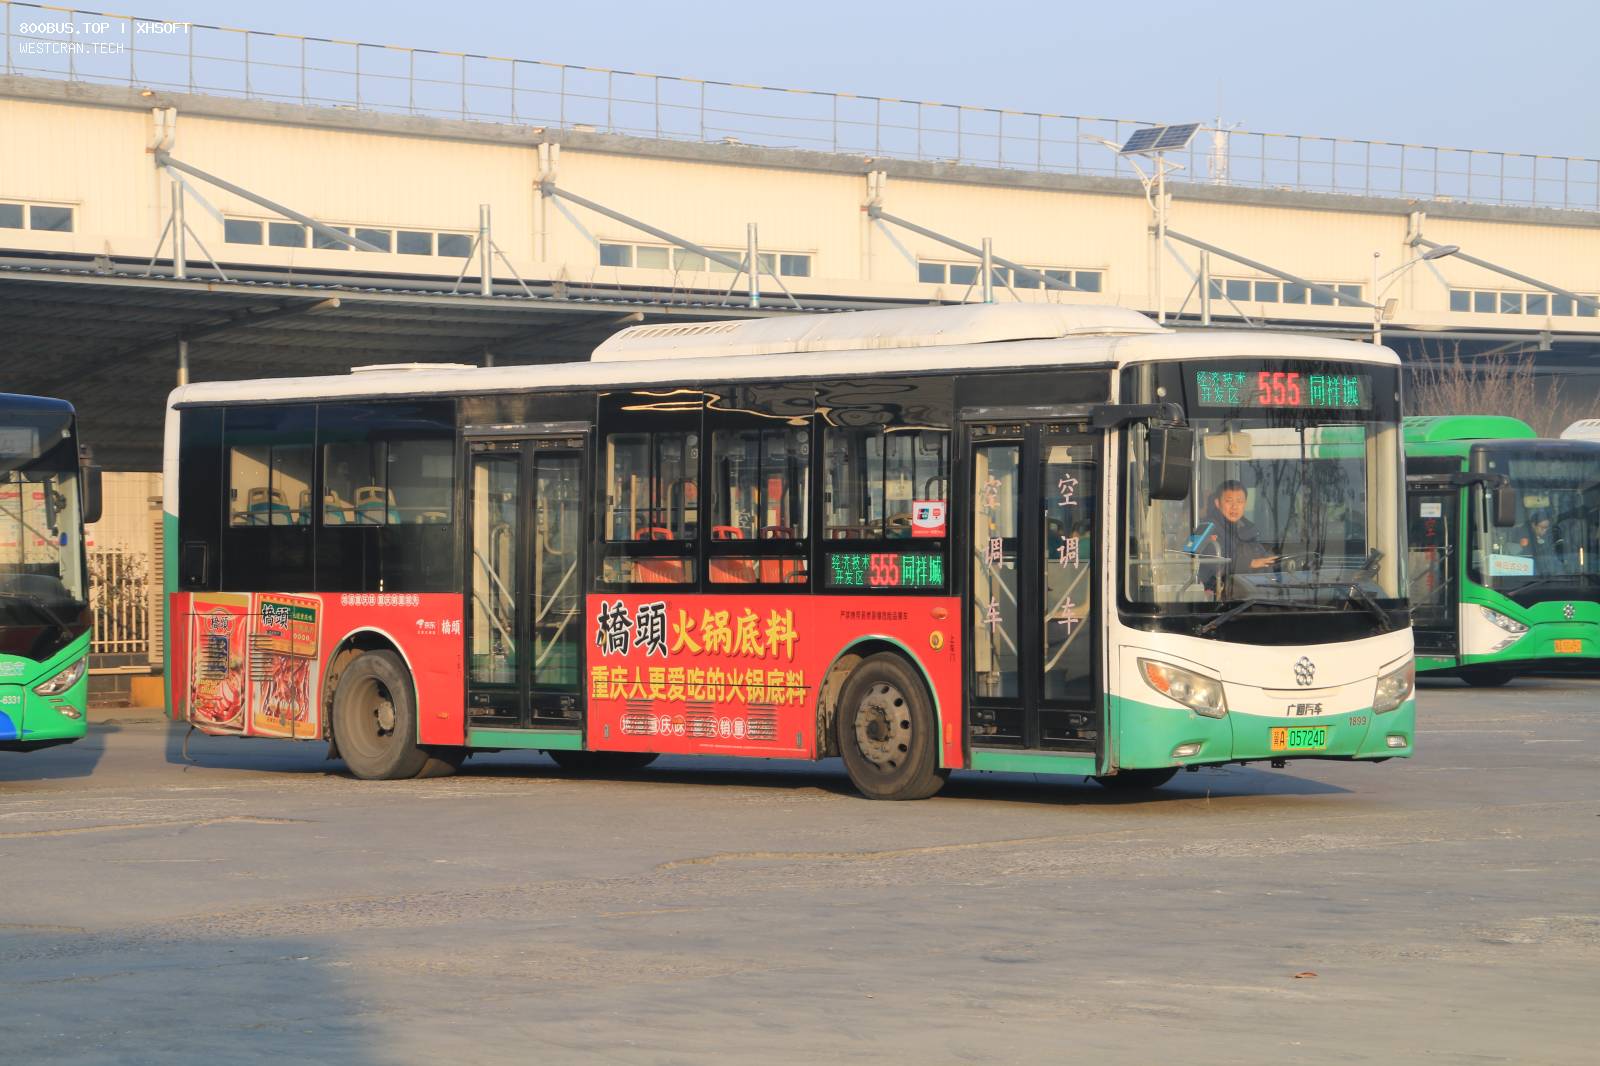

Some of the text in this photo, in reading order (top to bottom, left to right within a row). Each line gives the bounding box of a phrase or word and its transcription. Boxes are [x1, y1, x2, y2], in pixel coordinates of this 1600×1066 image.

[1196, 371, 1246, 388] 经济技术
[1200, 387, 1240, 403] 开发区
[1257, 371, 1301, 405] 555
[1309, 374, 1360, 407] 同祥城
[831, 554, 870, 570] 经济技术
[870, 553, 898, 586] 555
[983, 474, 1003, 633] 空调车
[1056, 472, 1080, 635] 空调车
[834, 570, 864, 585] 开发区
[902, 555, 943, 586] 同祥城
[594, 599, 799, 662] 橋頭 火锅底料
[591, 665, 807, 705] 重庆人更爱吃的火锅底料
[1349, 716, 1367, 727] 1899
